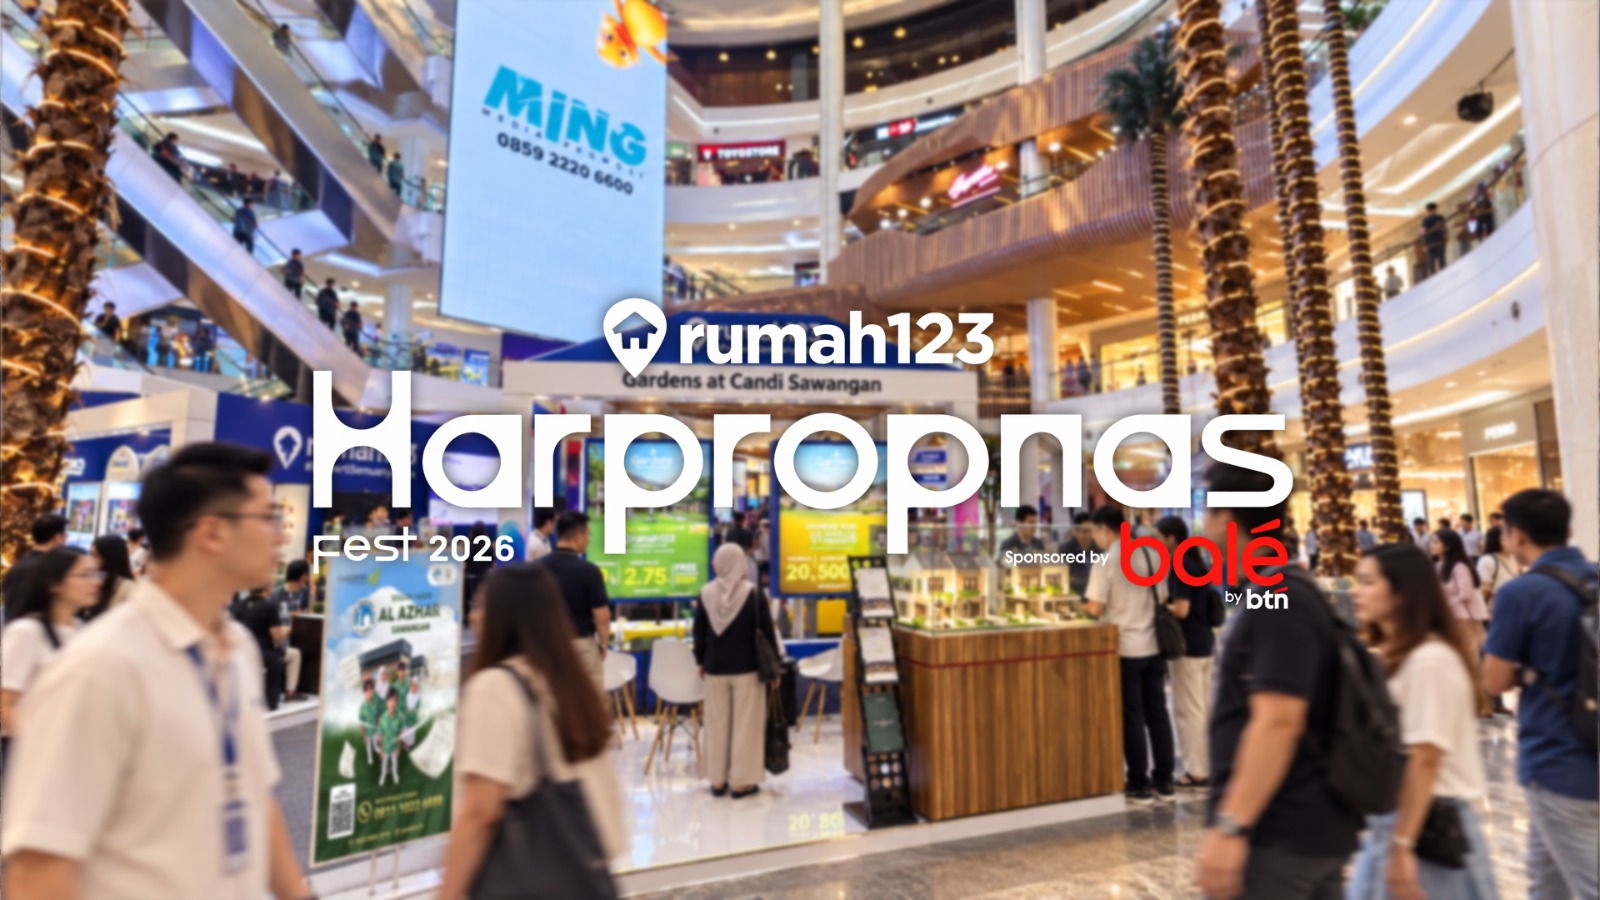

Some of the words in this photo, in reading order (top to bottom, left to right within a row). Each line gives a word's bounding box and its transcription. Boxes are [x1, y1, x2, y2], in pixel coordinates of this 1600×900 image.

[484, 65, 647, 166] MING
[497, 132, 545, 162] 0859
[548, 151, 590, 179] 2220
[594, 169, 634, 195] 6600
[622, 371, 702, 389] Gardens
[706, 374, 726, 389] at
[730, 372, 783, 390] Candi
[788, 373, 882, 396] Sawangan
[624, 567, 667, 586] 2.75
[378, 606, 394, 622] AL
[397, 603, 440, 620] AZHAR
